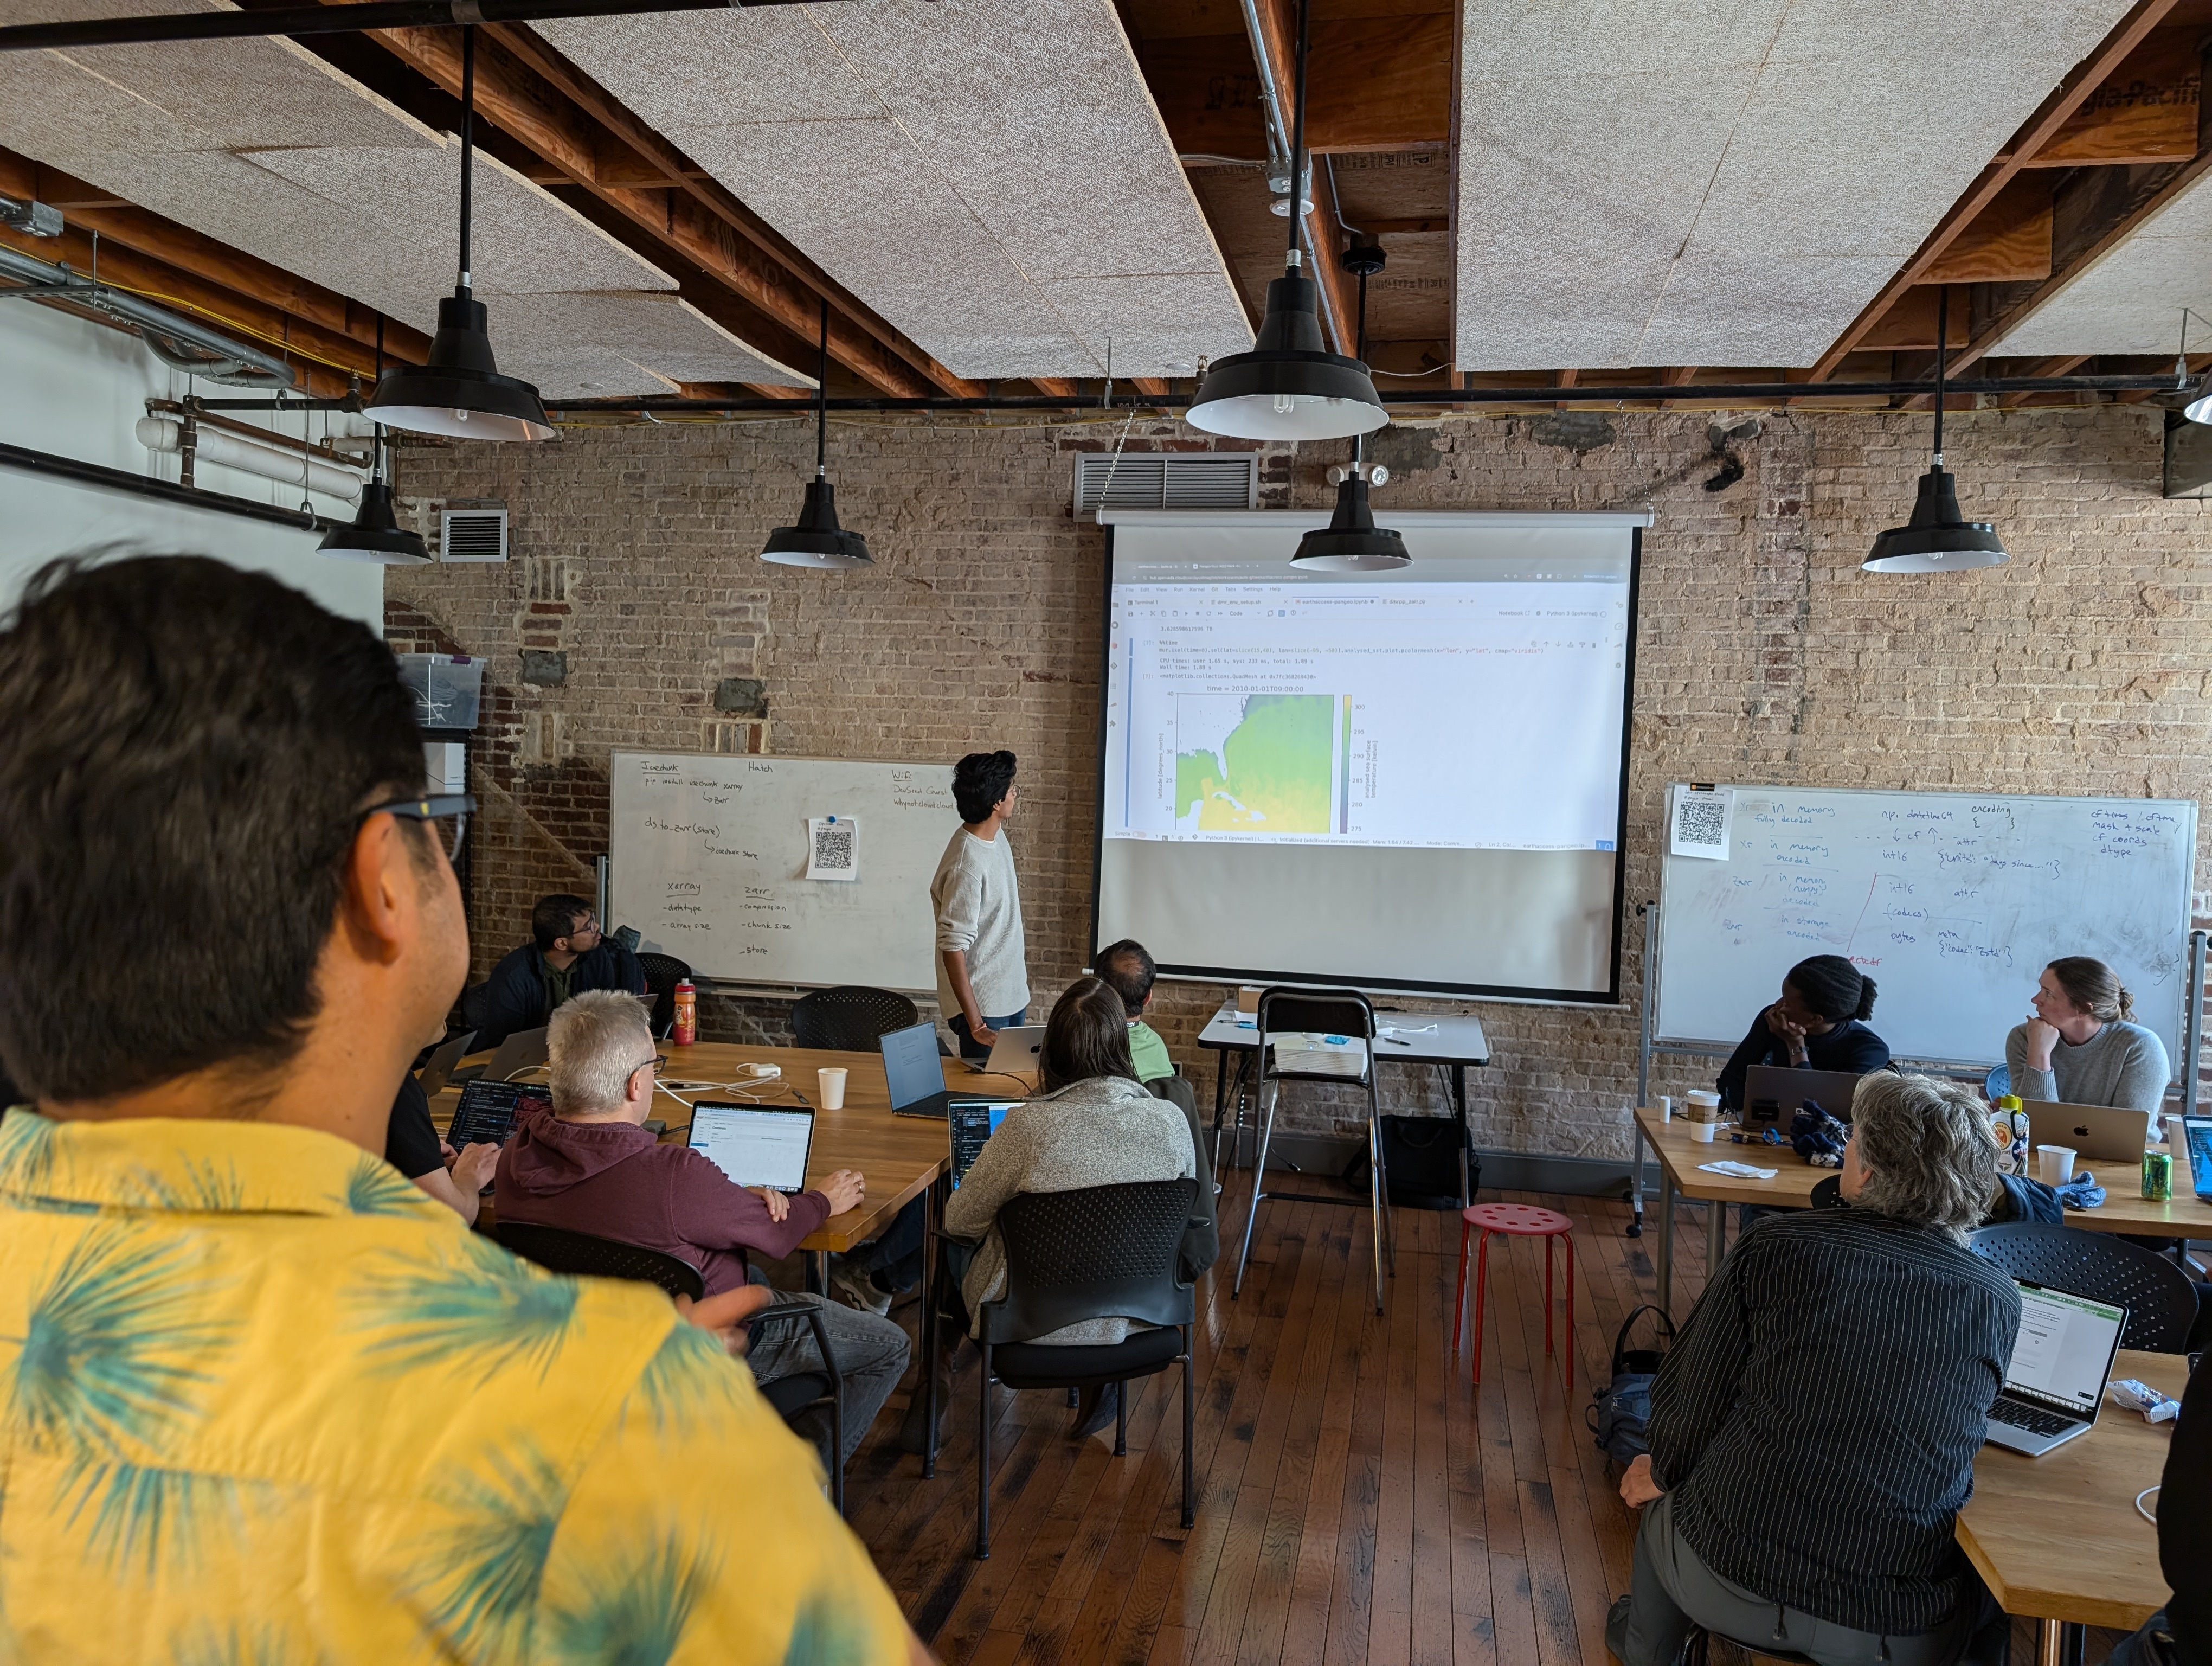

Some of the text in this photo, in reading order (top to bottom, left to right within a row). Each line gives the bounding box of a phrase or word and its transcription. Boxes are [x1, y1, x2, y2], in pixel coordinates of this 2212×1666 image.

[748, 761, 773, 773] Hatch
[891, 769, 912, 779] Wifi
[645, 778, 656, 786] pip
[689, 779, 718, 787] icechunk
[925, 785, 947, 796] Guest
[1771, 802, 1835, 817] in memory
[1971, 802, 2011, 819] encoding
[1754, 813, 1813, 829] fully decoded
[2112, 836, 2147, 847] coords
[1770, 839, 1829, 857] in memory
[1779, 872, 1787, 882] in
[667, 882, 701, 895] xarray
[1781, 914, 1789, 924] in
[670, 921, 691, 932] array
